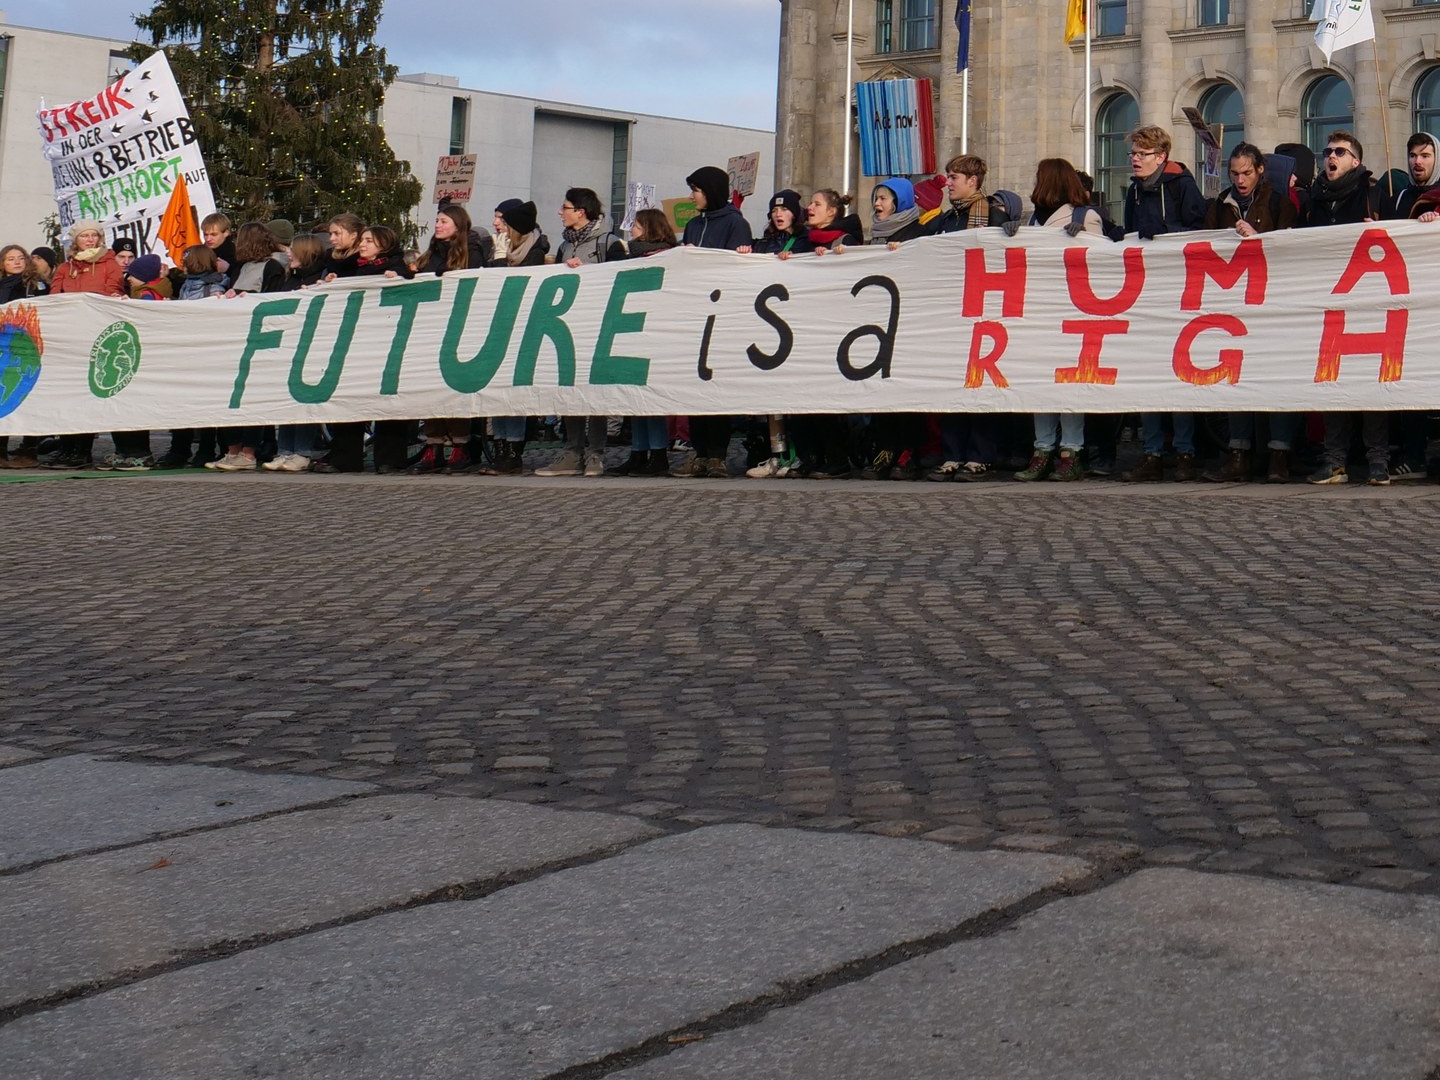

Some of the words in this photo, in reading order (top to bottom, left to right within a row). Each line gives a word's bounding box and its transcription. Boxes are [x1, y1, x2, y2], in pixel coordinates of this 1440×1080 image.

[39, 76, 136, 143] STREIK
[874, 109, 892, 130] Act
[896, 108, 918, 129] now!
[60, 140, 75, 157] IN
[78, 126, 103, 151] DER
[93, 150, 115, 179] &
[76, 156, 183, 221] ANTWORT
[184, 167, 207, 186] AUF
[229, 266, 665, 410] FUTURE
[697, 283, 795, 382] is
[835, 274, 901, 382] a
